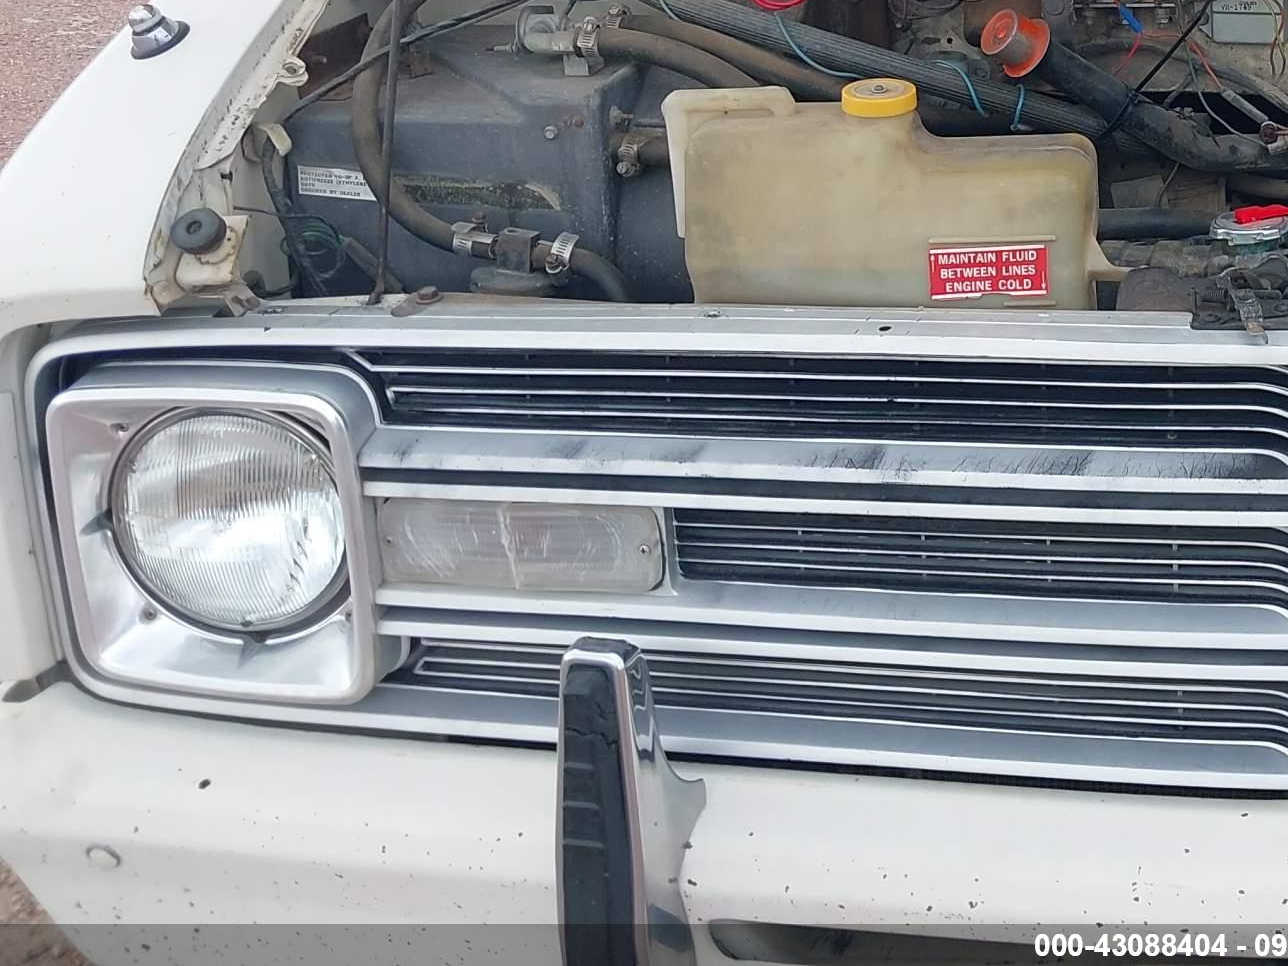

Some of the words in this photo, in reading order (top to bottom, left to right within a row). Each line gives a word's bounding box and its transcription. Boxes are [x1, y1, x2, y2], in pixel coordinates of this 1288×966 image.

[938, 252, 996, 265] MAINTAIN
[1002, 250, 1037, 262] FLUID
[940, 266, 996, 279] BETWEEN
[1002, 264, 1036, 276] LINES
[946, 280, 992, 292] ENGINE
[998, 278, 1032, 290] COLD
